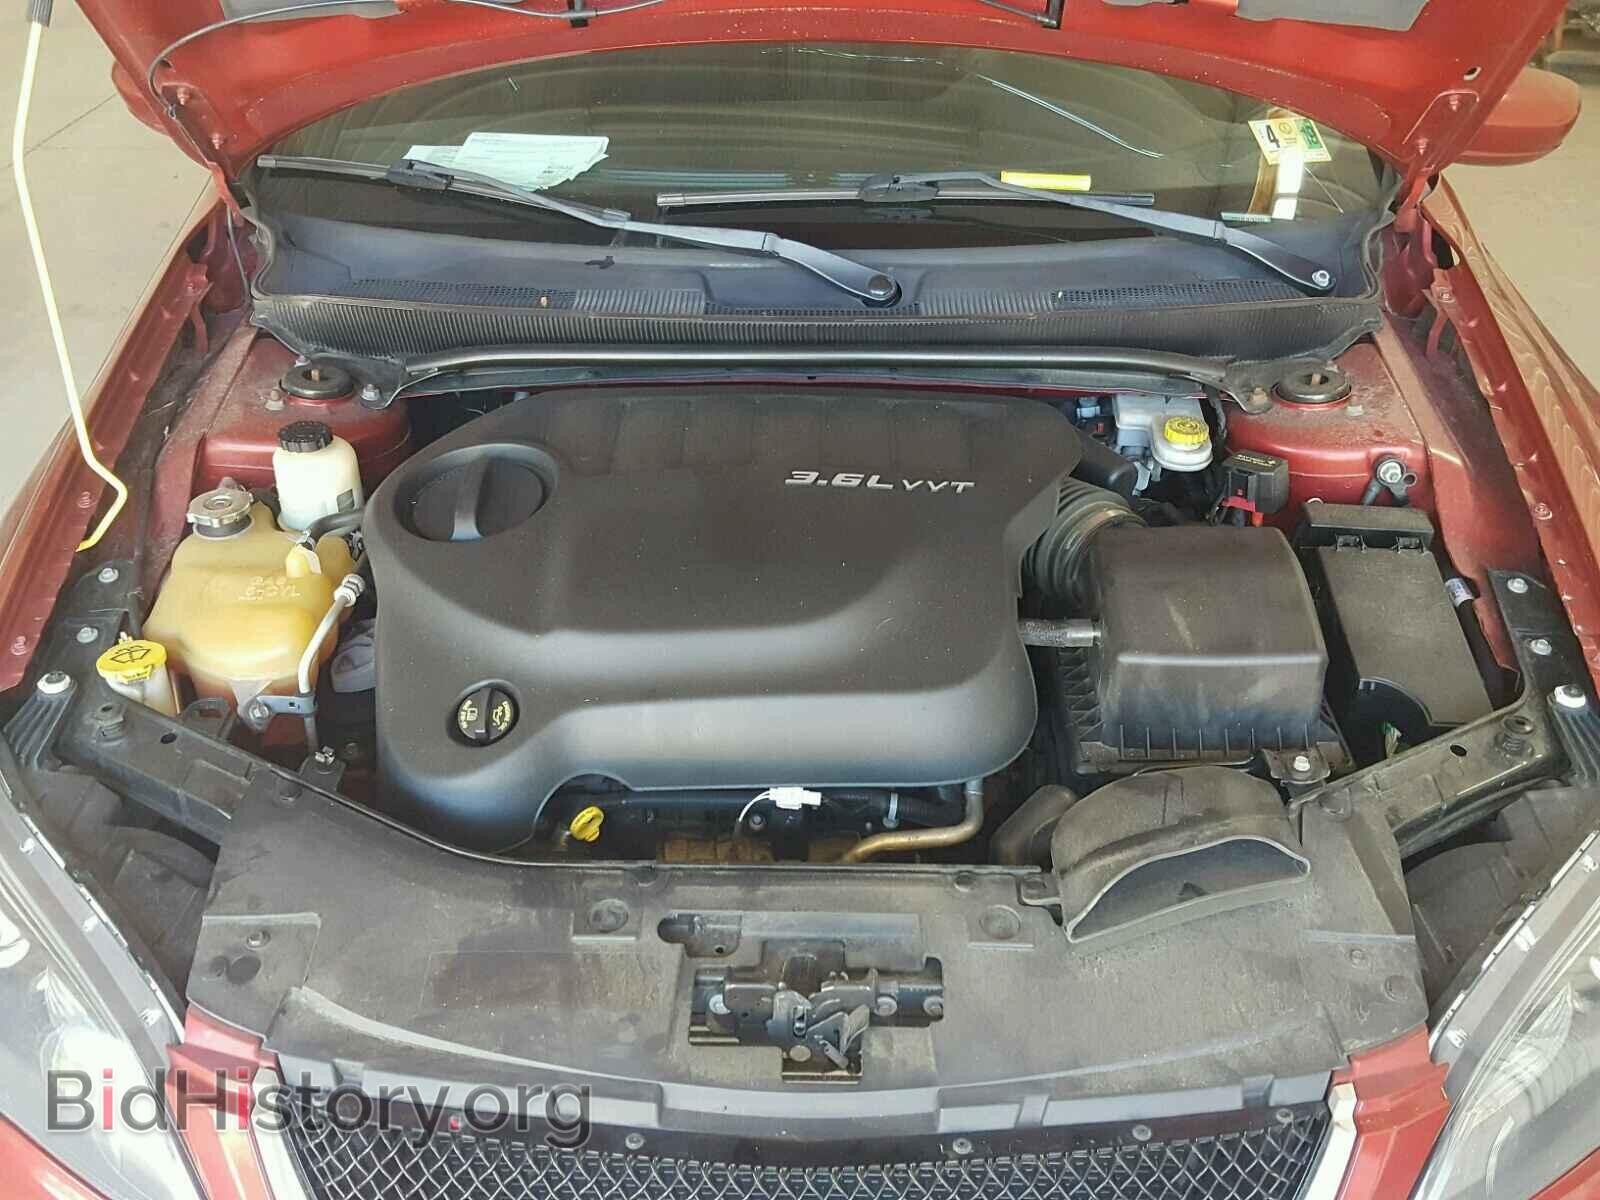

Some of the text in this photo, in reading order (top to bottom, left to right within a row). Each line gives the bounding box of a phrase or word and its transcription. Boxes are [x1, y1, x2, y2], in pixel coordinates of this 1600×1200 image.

[1265, 124, 1281, 148] 4
[785, 470, 975, 494] 3.6L VVT
